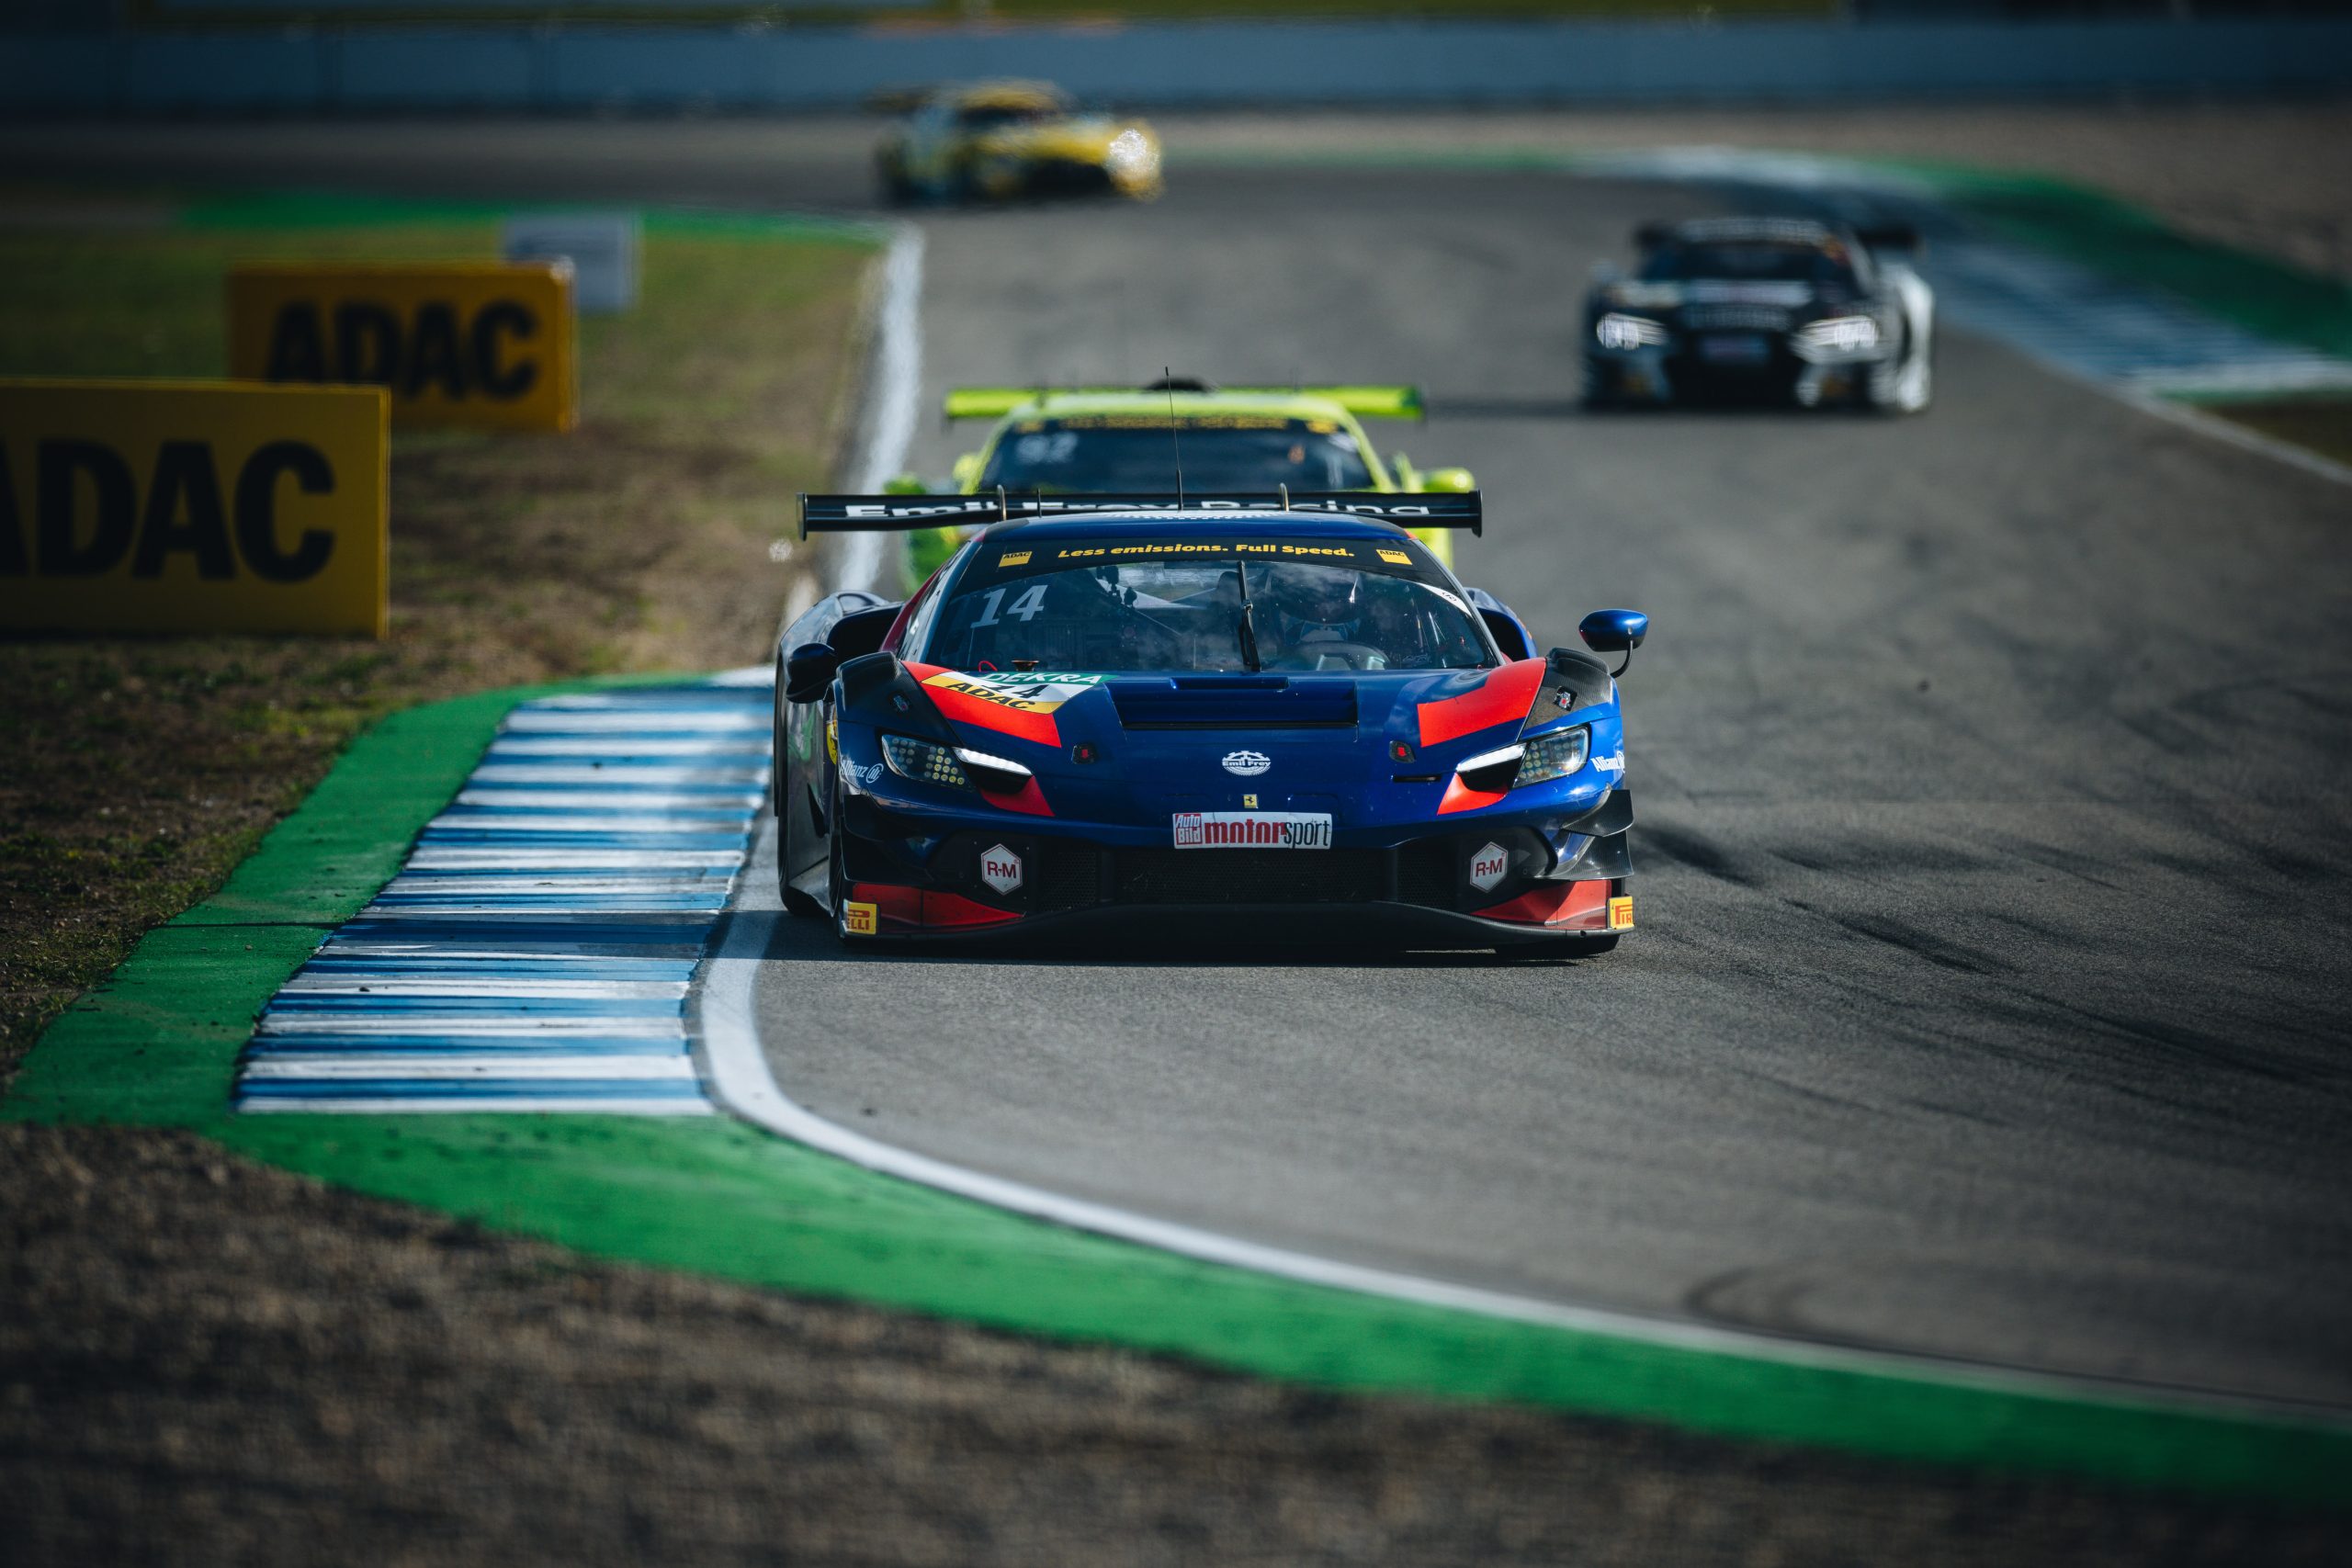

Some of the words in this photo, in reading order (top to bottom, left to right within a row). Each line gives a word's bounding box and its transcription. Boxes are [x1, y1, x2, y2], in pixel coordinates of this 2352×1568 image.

[266, 299, 538, 401] ADAC
[0, 436, 336, 584] DAC
[1003, 551, 1031, 559] ADAC
[1057, 548, 1105, 558] Less
[1110, 544, 1229, 555] emissions.
[1236, 544, 1276, 552] Full
[1282, 545, 1355, 557] Speed.
[1379, 549, 1406, 558] ADAC
[970, 584, 1048, 628] 14
[981, 672, 1102, 684] DEKRA
[946, 682, 1036, 709] ADAC
[1175, 814, 1201, 828] Auto
[1177, 828, 1201, 843] Bild
[987, 861, 1017, 879] R-M
[1476, 858, 1503, 877] R-M
